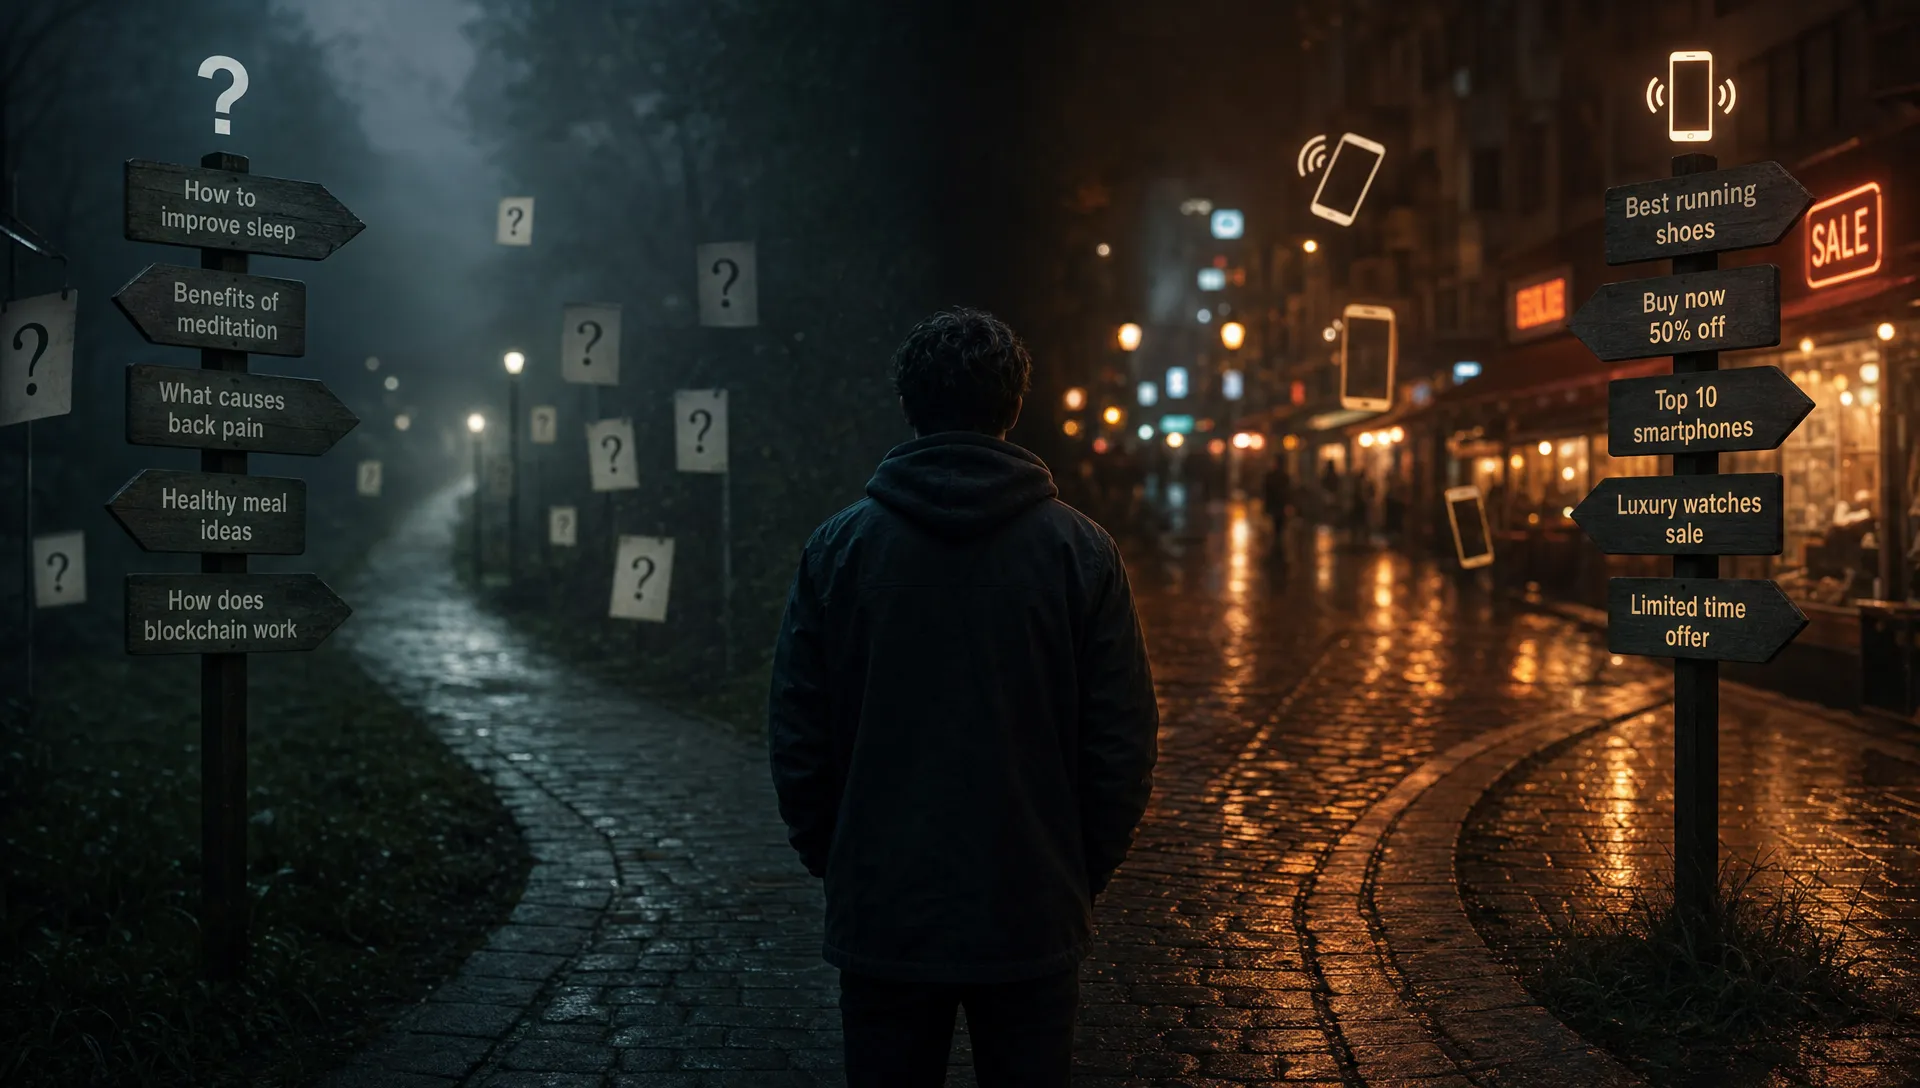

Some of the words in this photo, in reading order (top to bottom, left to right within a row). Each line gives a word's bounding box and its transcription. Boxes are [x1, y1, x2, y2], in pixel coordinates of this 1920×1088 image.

[197, 56, 249, 136] ?
[185, 180, 231, 204] How
[235, 188, 256, 208] to
[1626, 193, 1670, 219] Best
[1676, 183, 1757, 212] running
[161, 206, 241, 235] improve
[246, 217, 296, 245] sleep
[507, 206, 524, 236] ?
[1656, 222, 1716, 245] shoes
[1811, 206, 1869, 268] SALE
[174, 282, 255, 310] Benefits
[260, 292, 279, 312] of
[711, 257, 740, 309] ?
[1643, 293, 1679, 316] Buy
[1685, 290, 1726, 309] now
[177, 315, 278, 341] meditation
[1649, 319, 1691, 344] 50%
[1697, 315, 1726, 340] off
[577, 320, 603, 366] ?
[12, 322, 49, 397] ?
[159, 382, 213, 406] What
[218, 391, 285, 411] causes
[1654, 390, 1688, 415] Top
[1695, 386, 1717, 408] 10
[168, 412, 216, 436] back
[222, 417, 264, 442] pain
[689, 409, 712, 454] ?
[1633, 418, 1754, 446] smartphones
[602, 435, 622, 474] ?
[162, 488, 237, 517] Healthy
[243, 493, 287, 513] meal
[1618, 495, 1678, 520] Luxury
[1682, 492, 1762, 514] watches
[201, 518, 253, 540] ideas
[1665, 523, 1704, 544] sale
[47, 552, 69, 593] ?
[632, 556, 655, 601] ?
[168, 590, 212, 611] How
[217, 590, 264, 611] does
[1631, 594, 1698, 618] Limited
[1703, 597, 1746, 619] time
[144, 619, 247, 641] blockchain
[252, 619, 297, 639] work
[1665, 625, 1710, 648] offer
